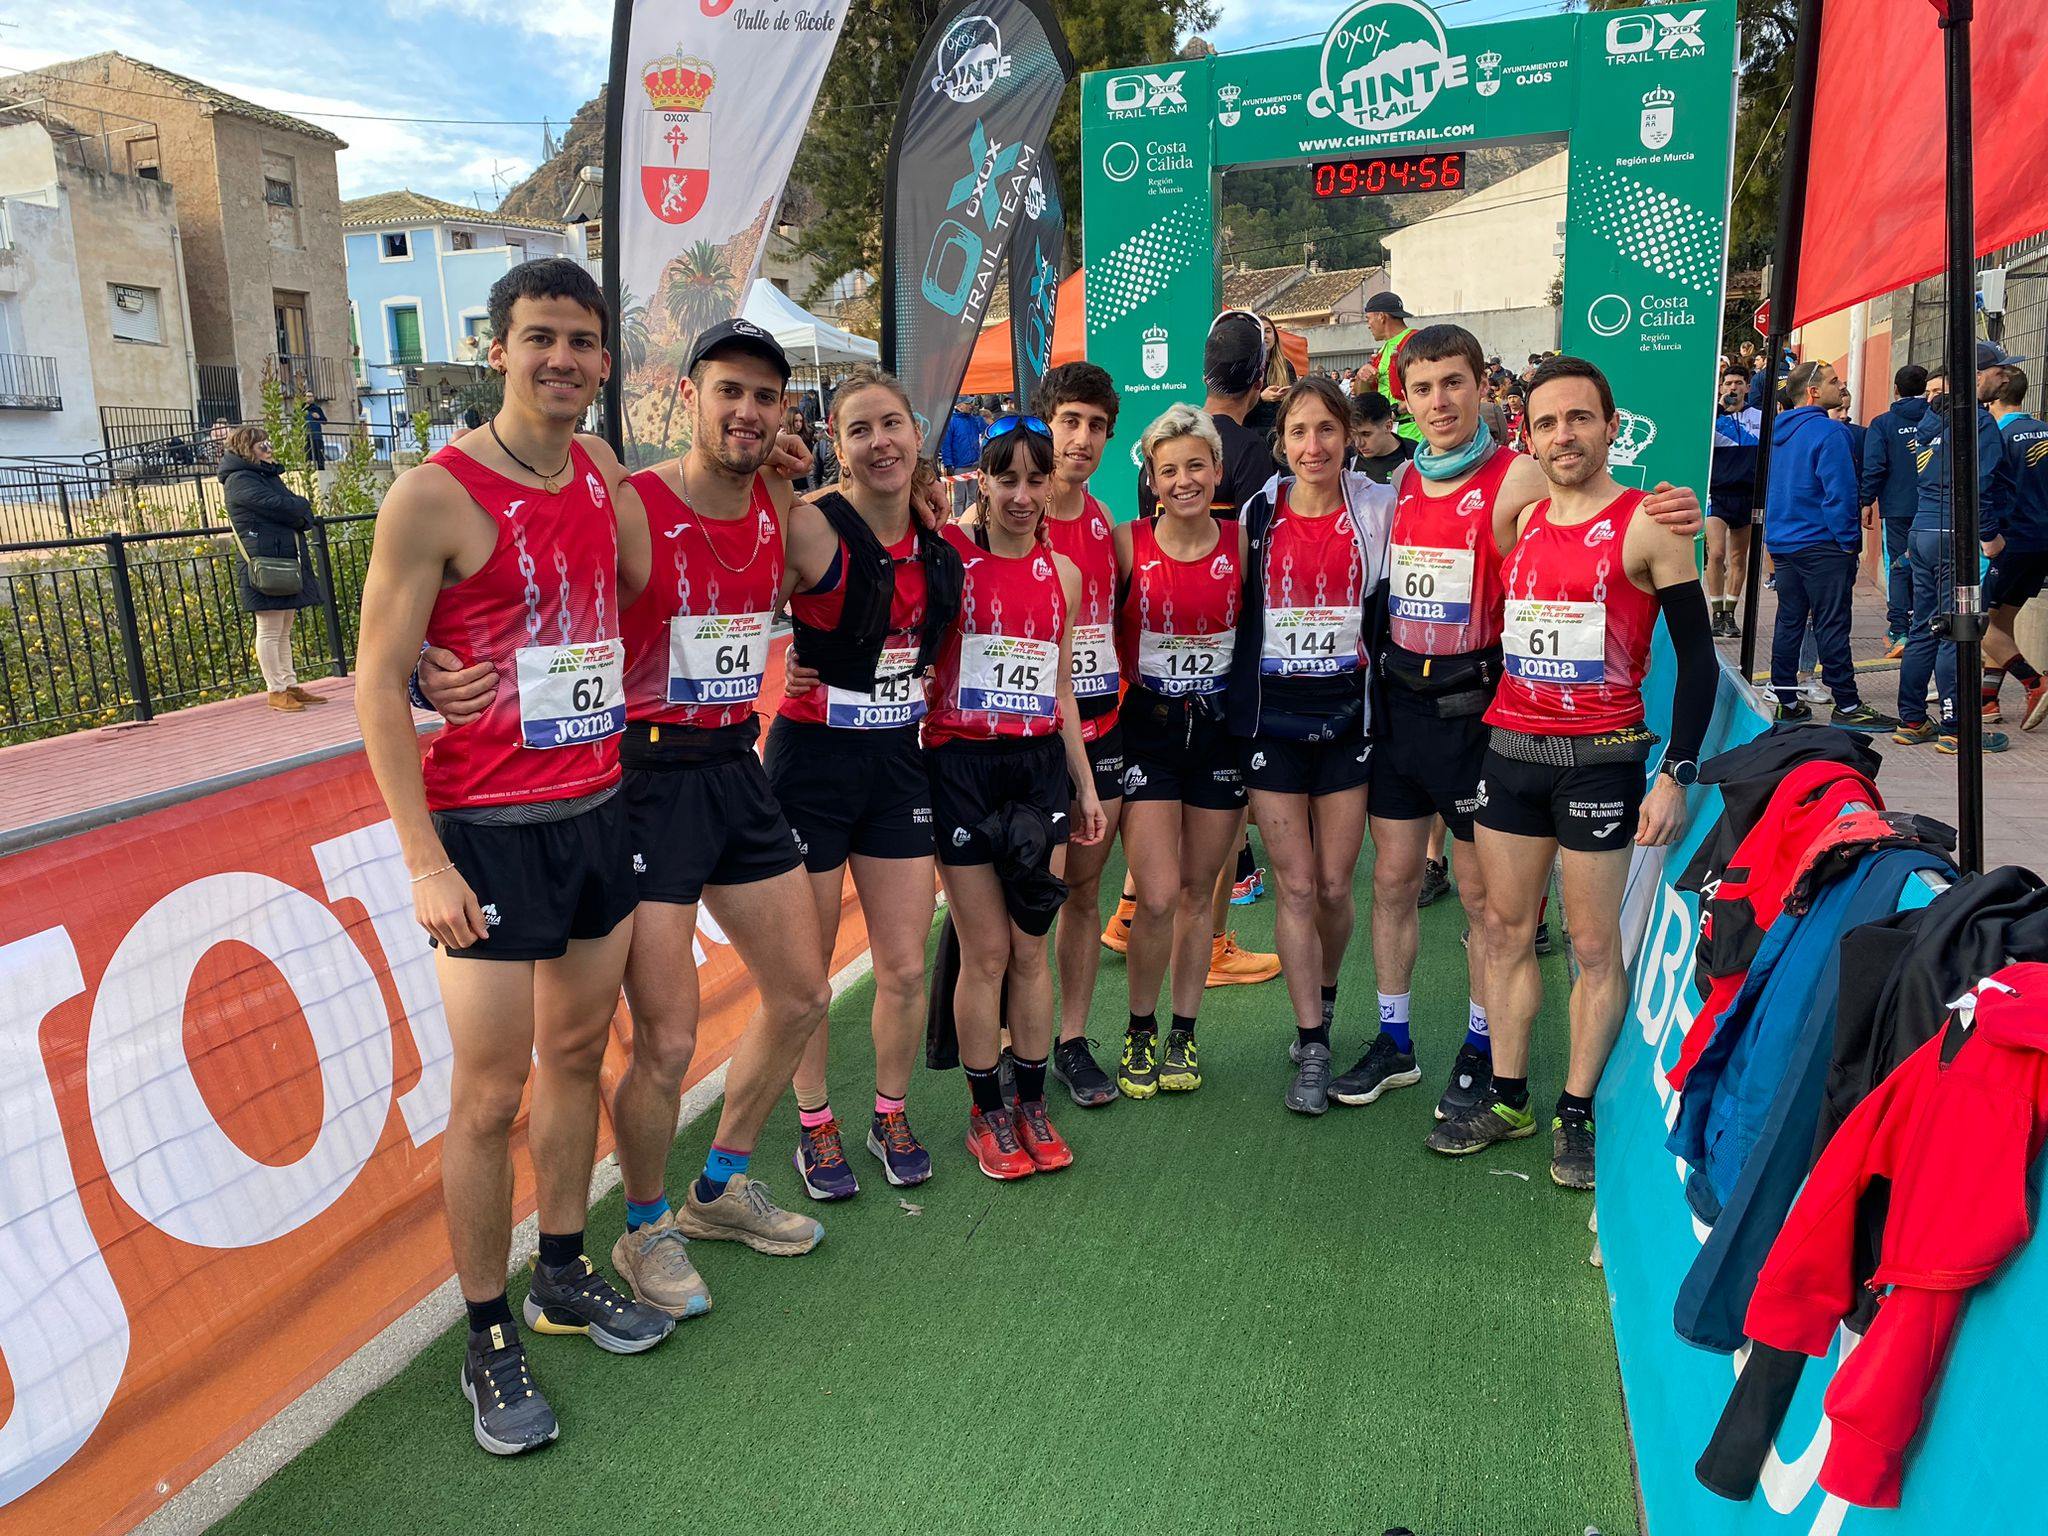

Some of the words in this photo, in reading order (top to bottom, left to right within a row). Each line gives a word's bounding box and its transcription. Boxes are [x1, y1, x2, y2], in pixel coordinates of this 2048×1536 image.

[734, 9, 769, 30] Valle
[773, 10, 790, 31] de
[794, 10, 835, 32] Ricote
[1659, 23, 1701, 36] OXOX
[1337, 19, 1390, 63] OXOX
[1605, 52, 1653, 66] TRAIL
[1658, 46, 1705, 61] TEAM
[1502, 62, 1558, 74] AYUNTAMIENTO
[1559, 60, 1568, 68] DE
[1516, 70, 1552, 85] OJÓS
[953, 84, 985, 97] TRAIL
[1149, 83, 1182, 95] OXOX
[1307, 54, 1469, 119] CHINTE
[1242, 95, 1291, 106] AYUNTAMIENTO
[1293, 93, 1302, 102] DE
[663, 112, 690, 123] OXOX
[1107, 109, 1146, 120] TRAIL
[1150, 104, 1187, 116] TEAM
[1254, 103, 1287, 117] OJÓS
[1354, 100, 1421, 125] TRAIL
[1298, 124, 1475, 152] WWW.CHINTETRAIL.COM
[1146, 141, 1187, 155] Costa
[1146, 155, 1193, 171] Cálida
[1616, 155, 1648, 167] Región
[1650, 155, 1661, 164] de
[1663, 152, 1695, 162] Murcia
[966, 137, 1002, 218] OXOX
[1148, 177, 1173, 187] Región
[1316, 155, 1460, 196] 09:04:56
[1158, 186, 1183, 195] Murcia
[961, 243, 1002, 325] TRAIL
[993, 144, 1035, 230] TEAM
[1640, 295, 1689, 310] Costa
[1640, 310, 1696, 327] Cálida
[1640, 333, 1670, 344] Región
[1640, 343, 1650, 352] de
[1653, 342, 1682, 352] Murcia
[1124, 383, 1150, 393] Región
[1162, 382, 1187, 391] Murcia
[1405, 572, 1435, 598] 60
[1285, 631, 1336, 656] 144
[1529, 629, 1560, 656] 61
[715, 644, 750, 675] 64
[1071, 650, 1097, 675] 63
[1167, 653, 1214, 676] 142
[993, 663, 1040, 691] 145
[572, 676, 605, 712] 62
[1569, 809, 1588, 818] TRAIL
[1591, 809, 1624, 818] RUNNING
